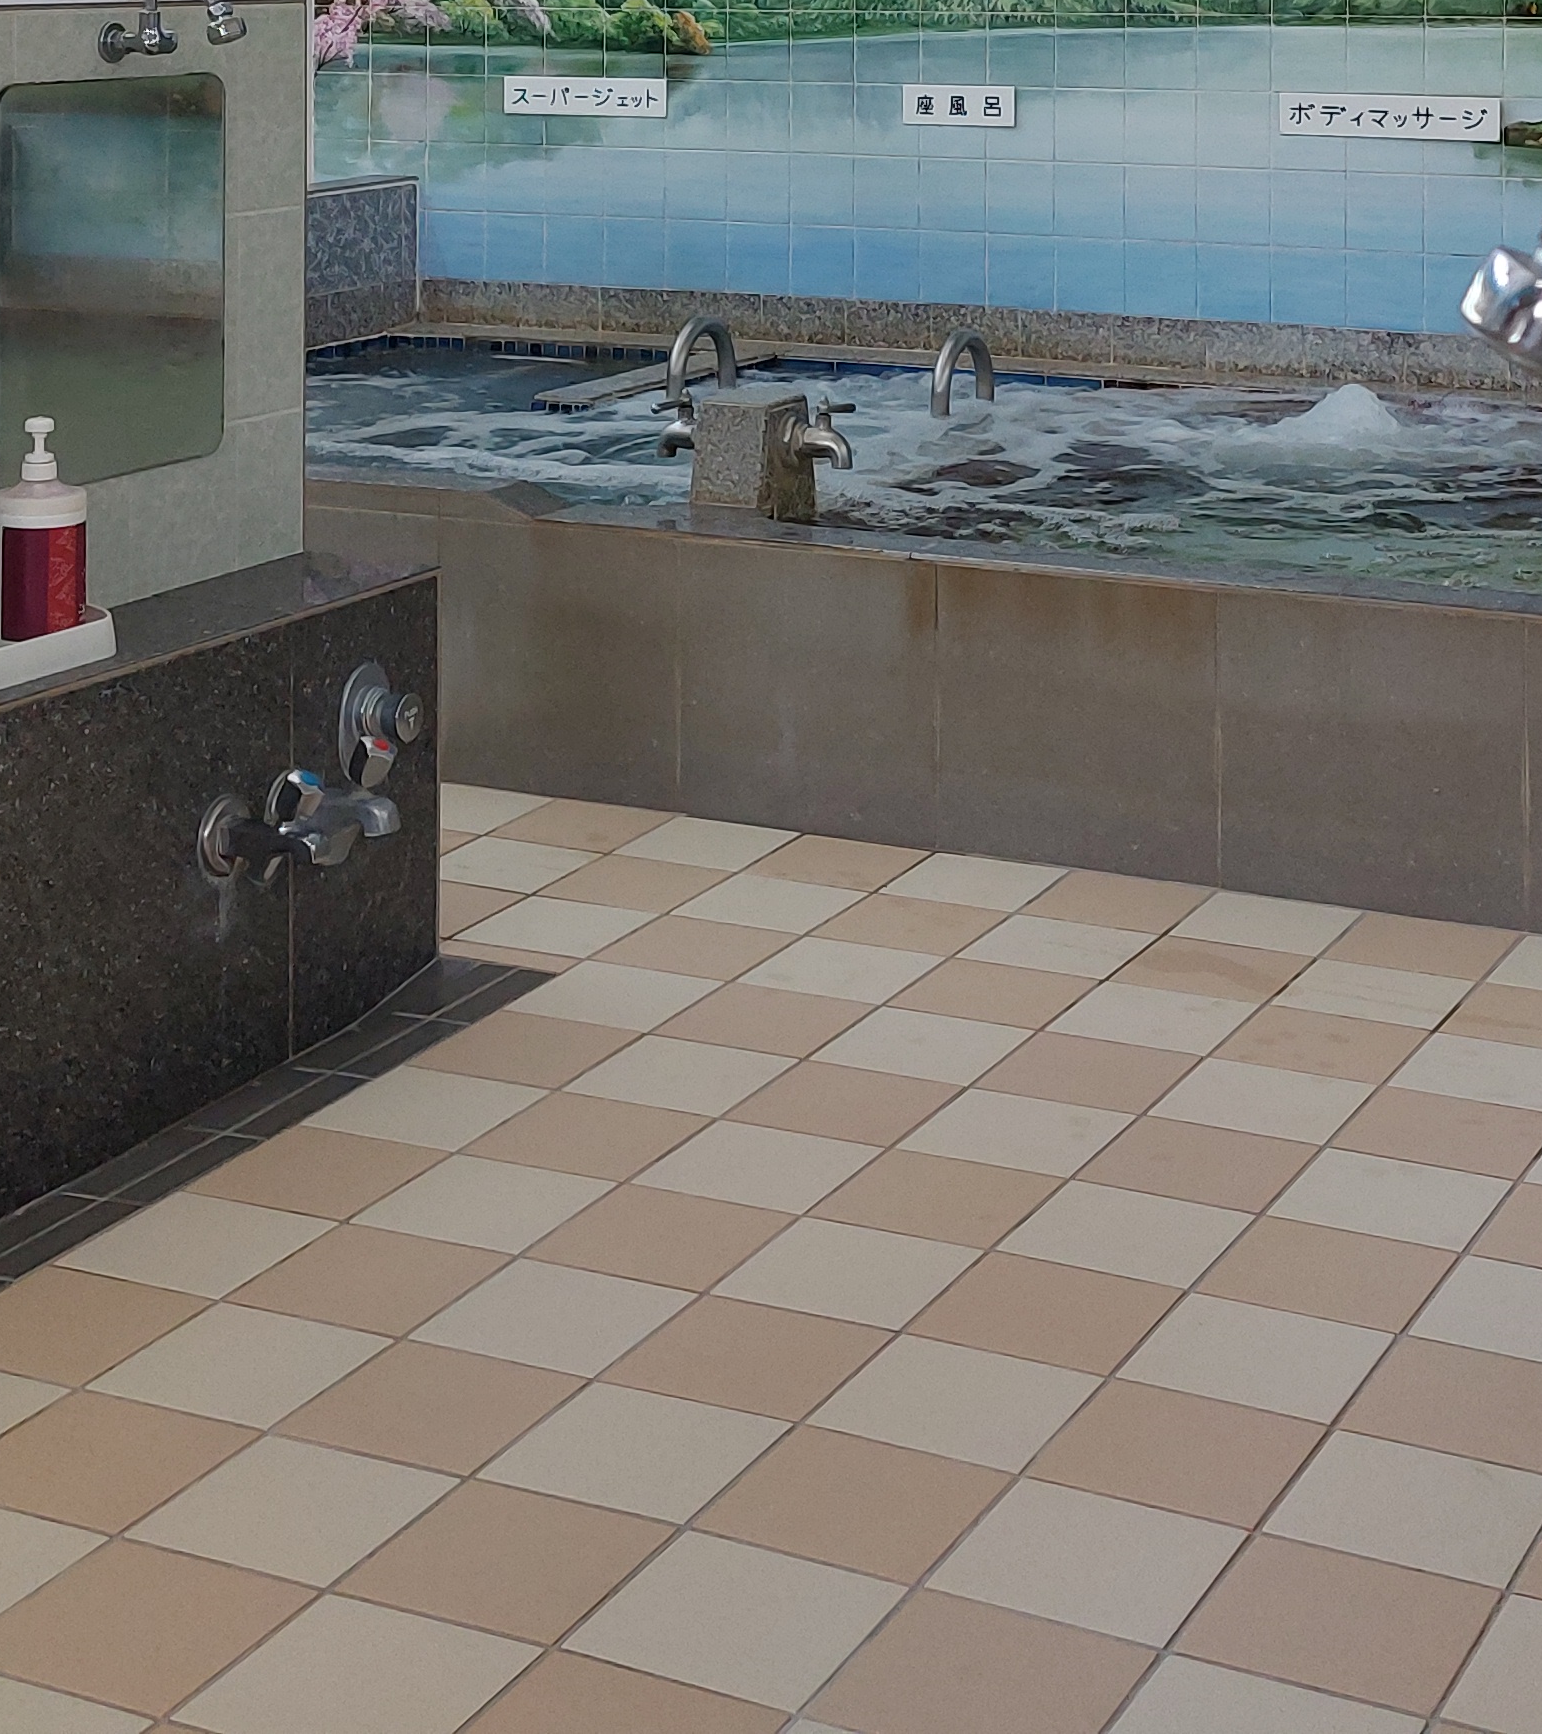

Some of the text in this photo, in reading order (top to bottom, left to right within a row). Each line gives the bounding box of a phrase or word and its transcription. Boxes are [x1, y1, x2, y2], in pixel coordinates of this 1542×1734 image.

[512, 87, 658, 108] スーパージェット
[916, 95, 1001, 117] 座風呂
[1289, 103, 1488, 130] ボディマッサージ
